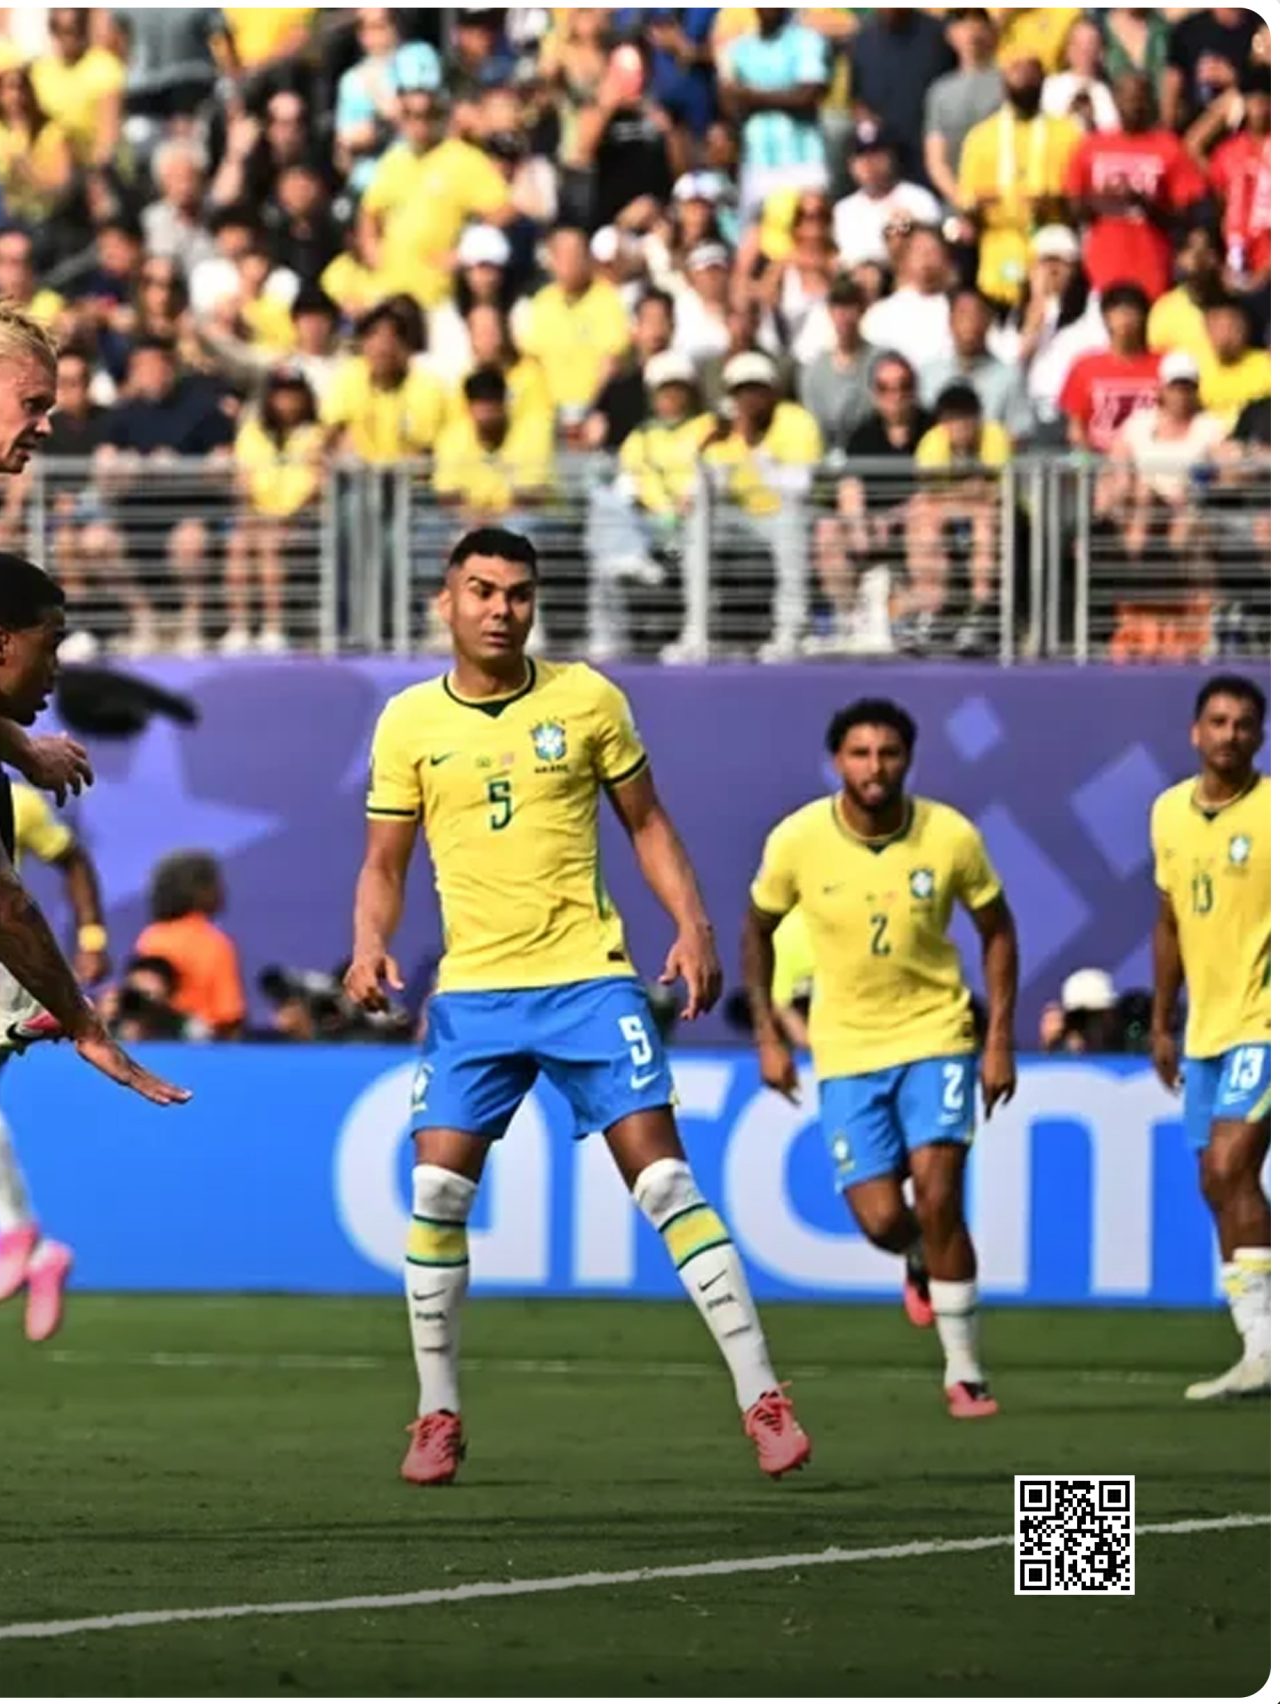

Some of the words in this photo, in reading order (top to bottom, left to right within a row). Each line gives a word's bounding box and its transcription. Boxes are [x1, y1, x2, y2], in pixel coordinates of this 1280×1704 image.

[488, 780, 512, 830] 5
[1191, 873, 1214, 914] 13
[871, 914, 891, 956] 2
[619, 1015, 652, 1066] 5
[942, 1063, 963, 1110] 2
[1230, 1047, 1265, 1090] 13
